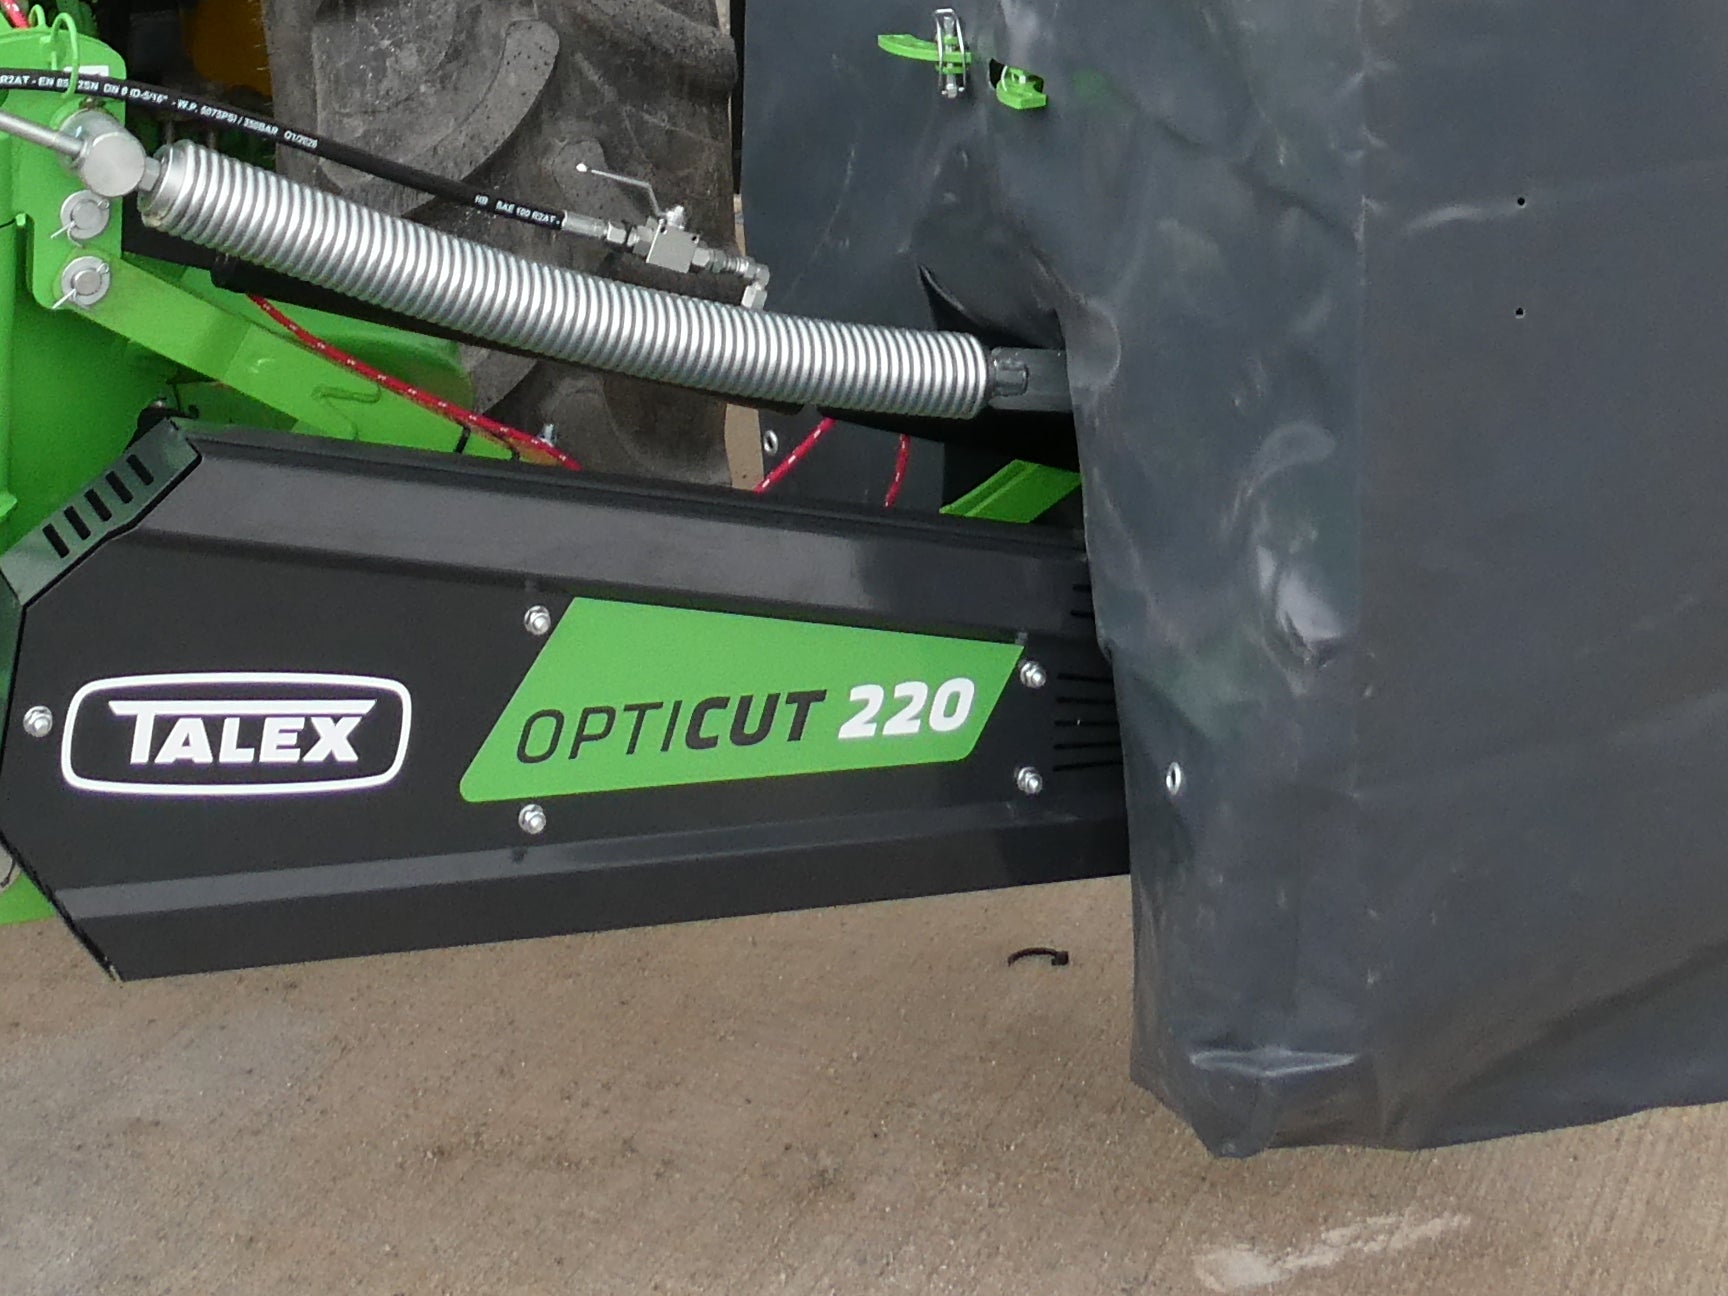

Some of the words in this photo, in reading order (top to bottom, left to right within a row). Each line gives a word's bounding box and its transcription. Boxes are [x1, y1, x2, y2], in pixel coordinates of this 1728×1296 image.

[0, 74, 30, 85] R2AT
[107, 699, 378, 765] TALEX
[515, 689, 828, 764] OPTICUT
[837, 676, 976, 740] 220
